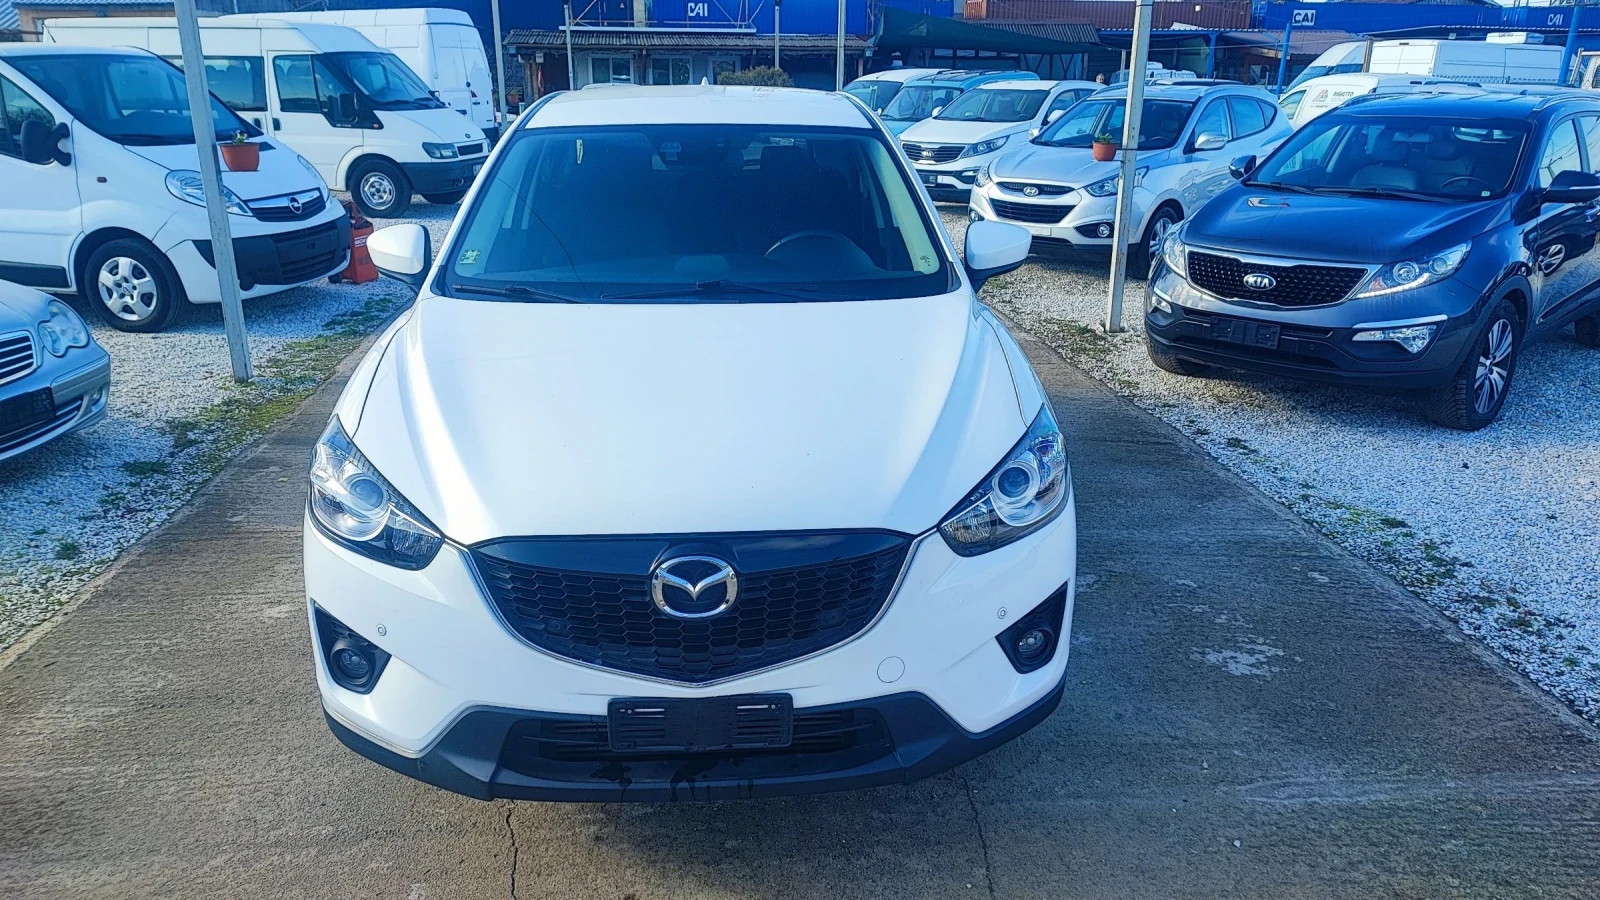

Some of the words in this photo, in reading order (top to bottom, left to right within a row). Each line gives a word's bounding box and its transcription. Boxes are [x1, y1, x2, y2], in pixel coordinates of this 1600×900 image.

[687, 2, 708, 17] CAI
[1293, 12, 1315, 23] CAI
[1547, 13, 1564, 26] CAI
[1247, 276, 1270, 288] KIA
